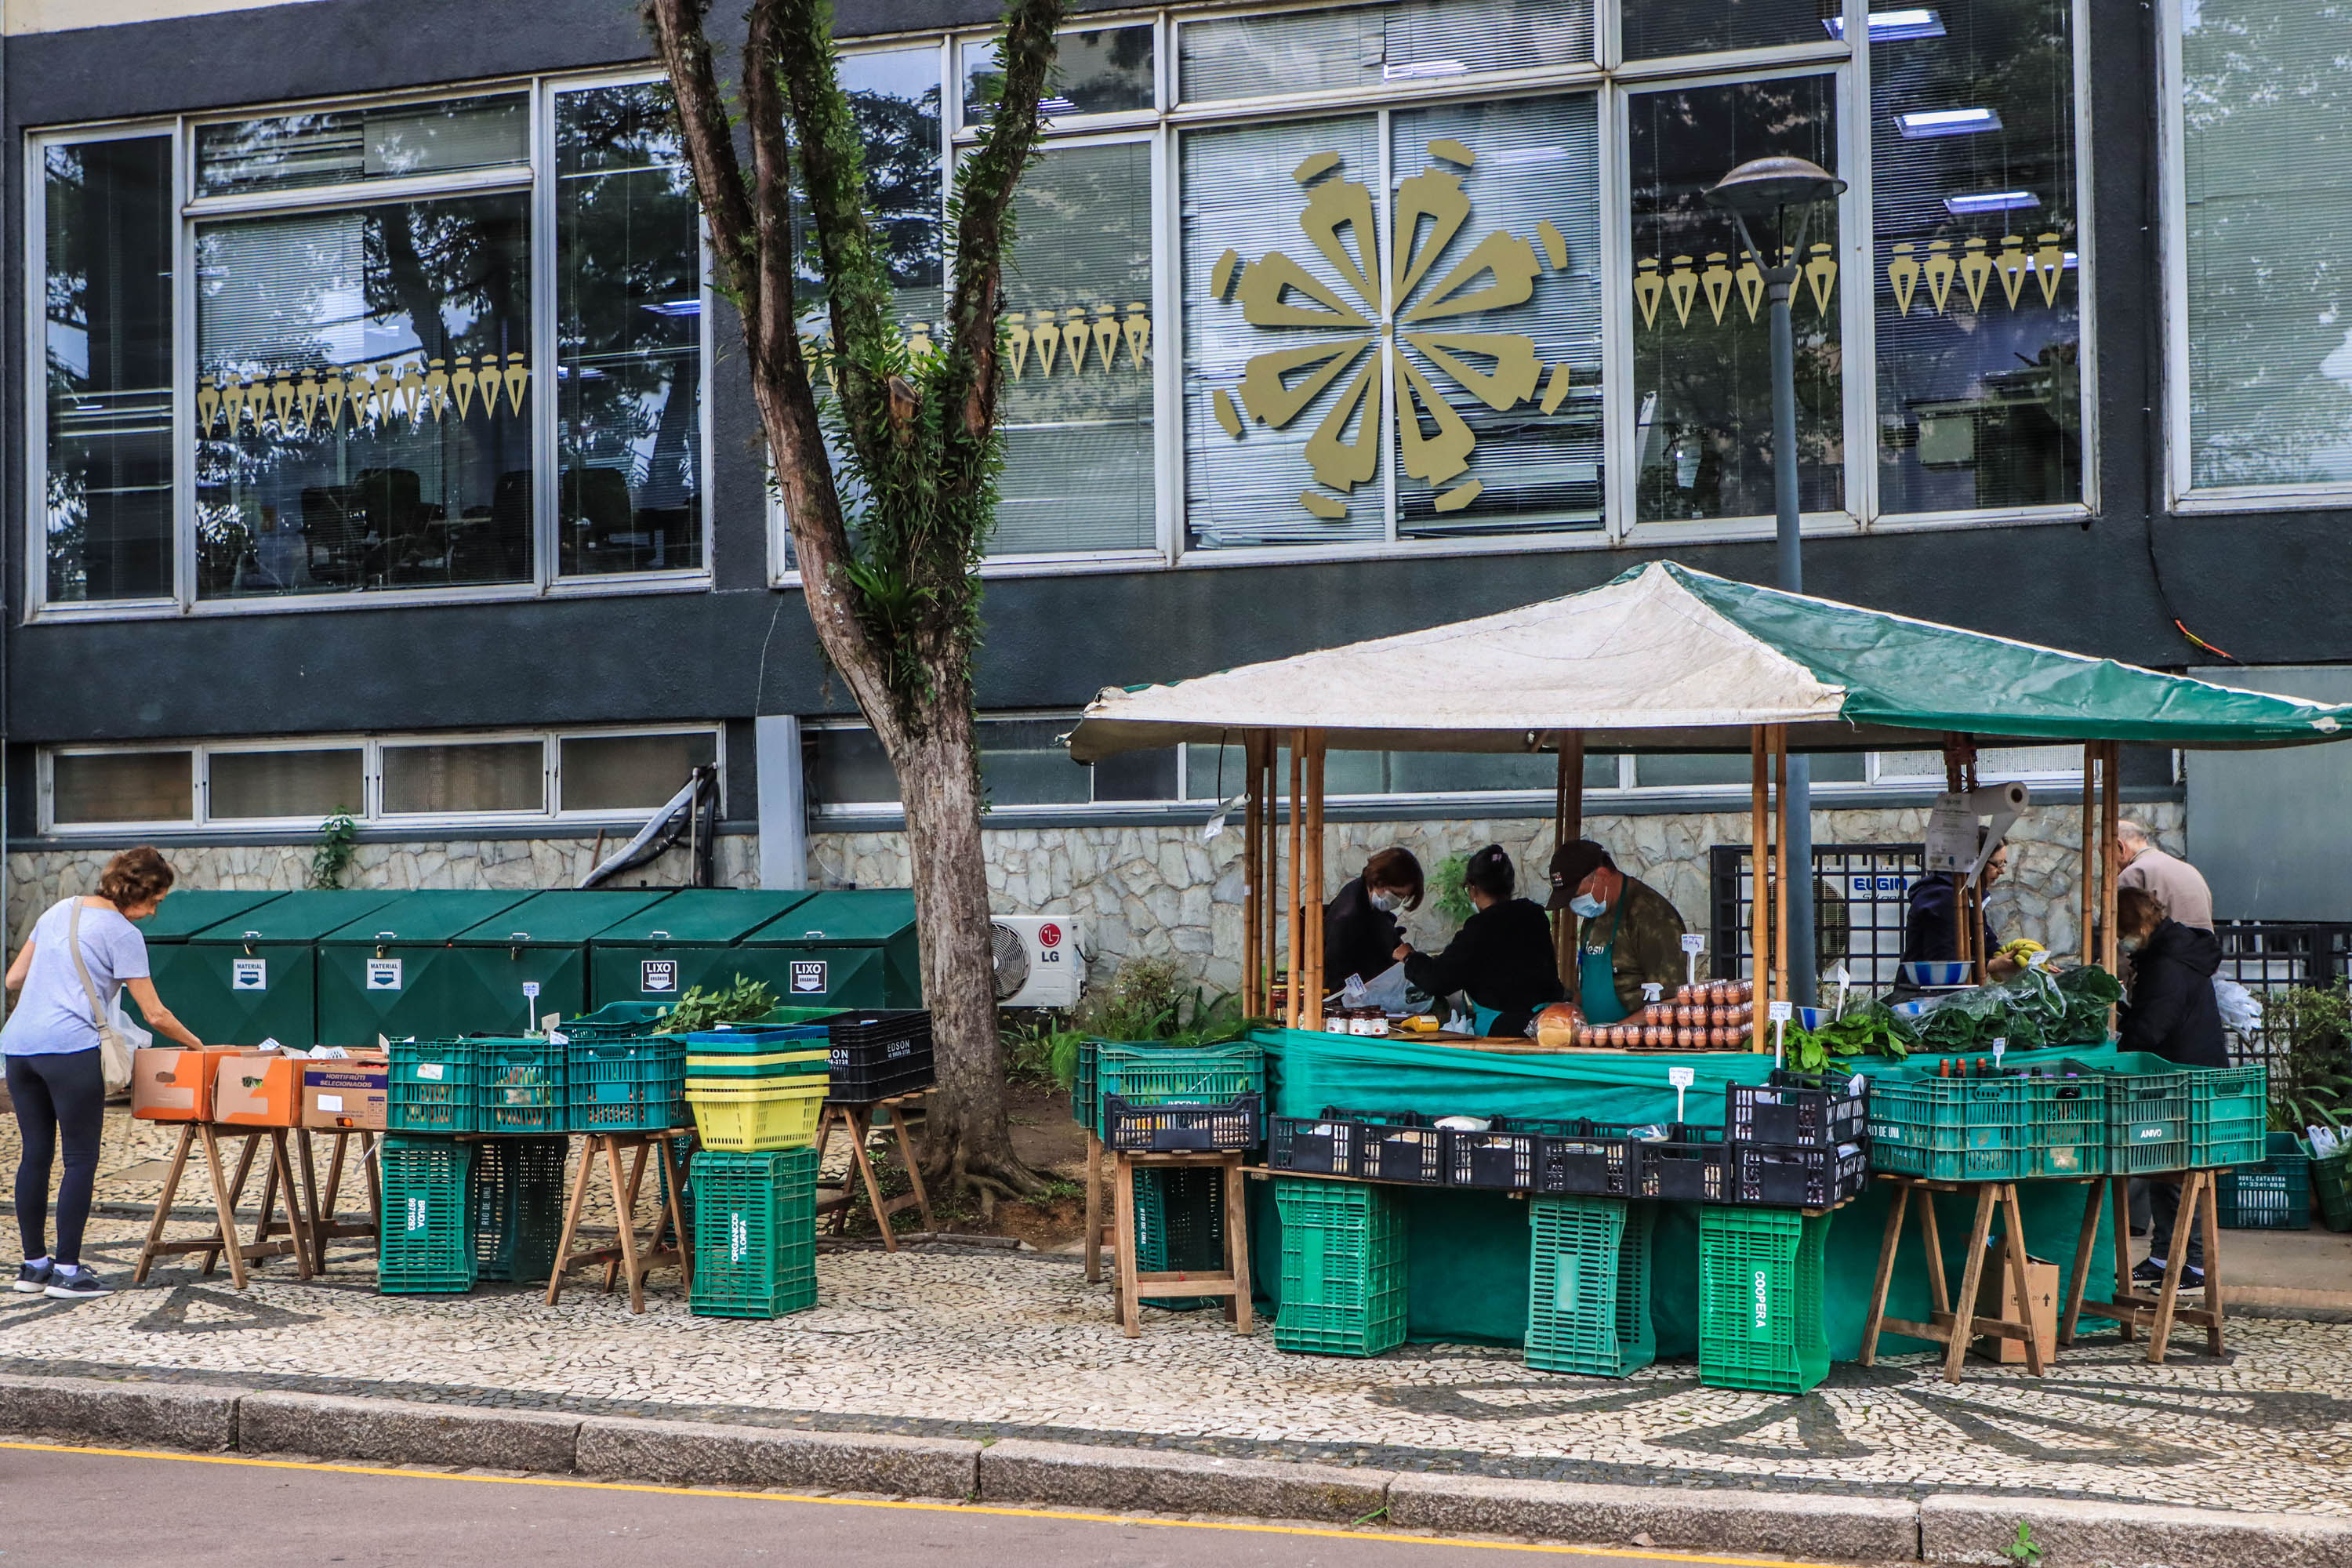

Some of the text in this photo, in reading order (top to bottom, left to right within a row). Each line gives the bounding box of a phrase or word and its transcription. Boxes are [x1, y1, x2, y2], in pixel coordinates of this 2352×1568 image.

[1853, 877, 1907, 891] ELGIN
[1041, 951, 1060, 963] LG
[646, 963, 672, 973] LIXO
[796, 964, 822, 974] LIXO
[887, 1039, 910, 1053] EDSON
[1878, 1125, 1887, 1138] DE
[1888, 1126, 1900, 1139] UNA
[481, 1186, 491, 1225] RIO DE UNA
[417, 1200, 426, 1228] BRUDA
[1141, 1221, 1146, 1231] DE
[1755, 1271, 1766, 1328] COOPERA
